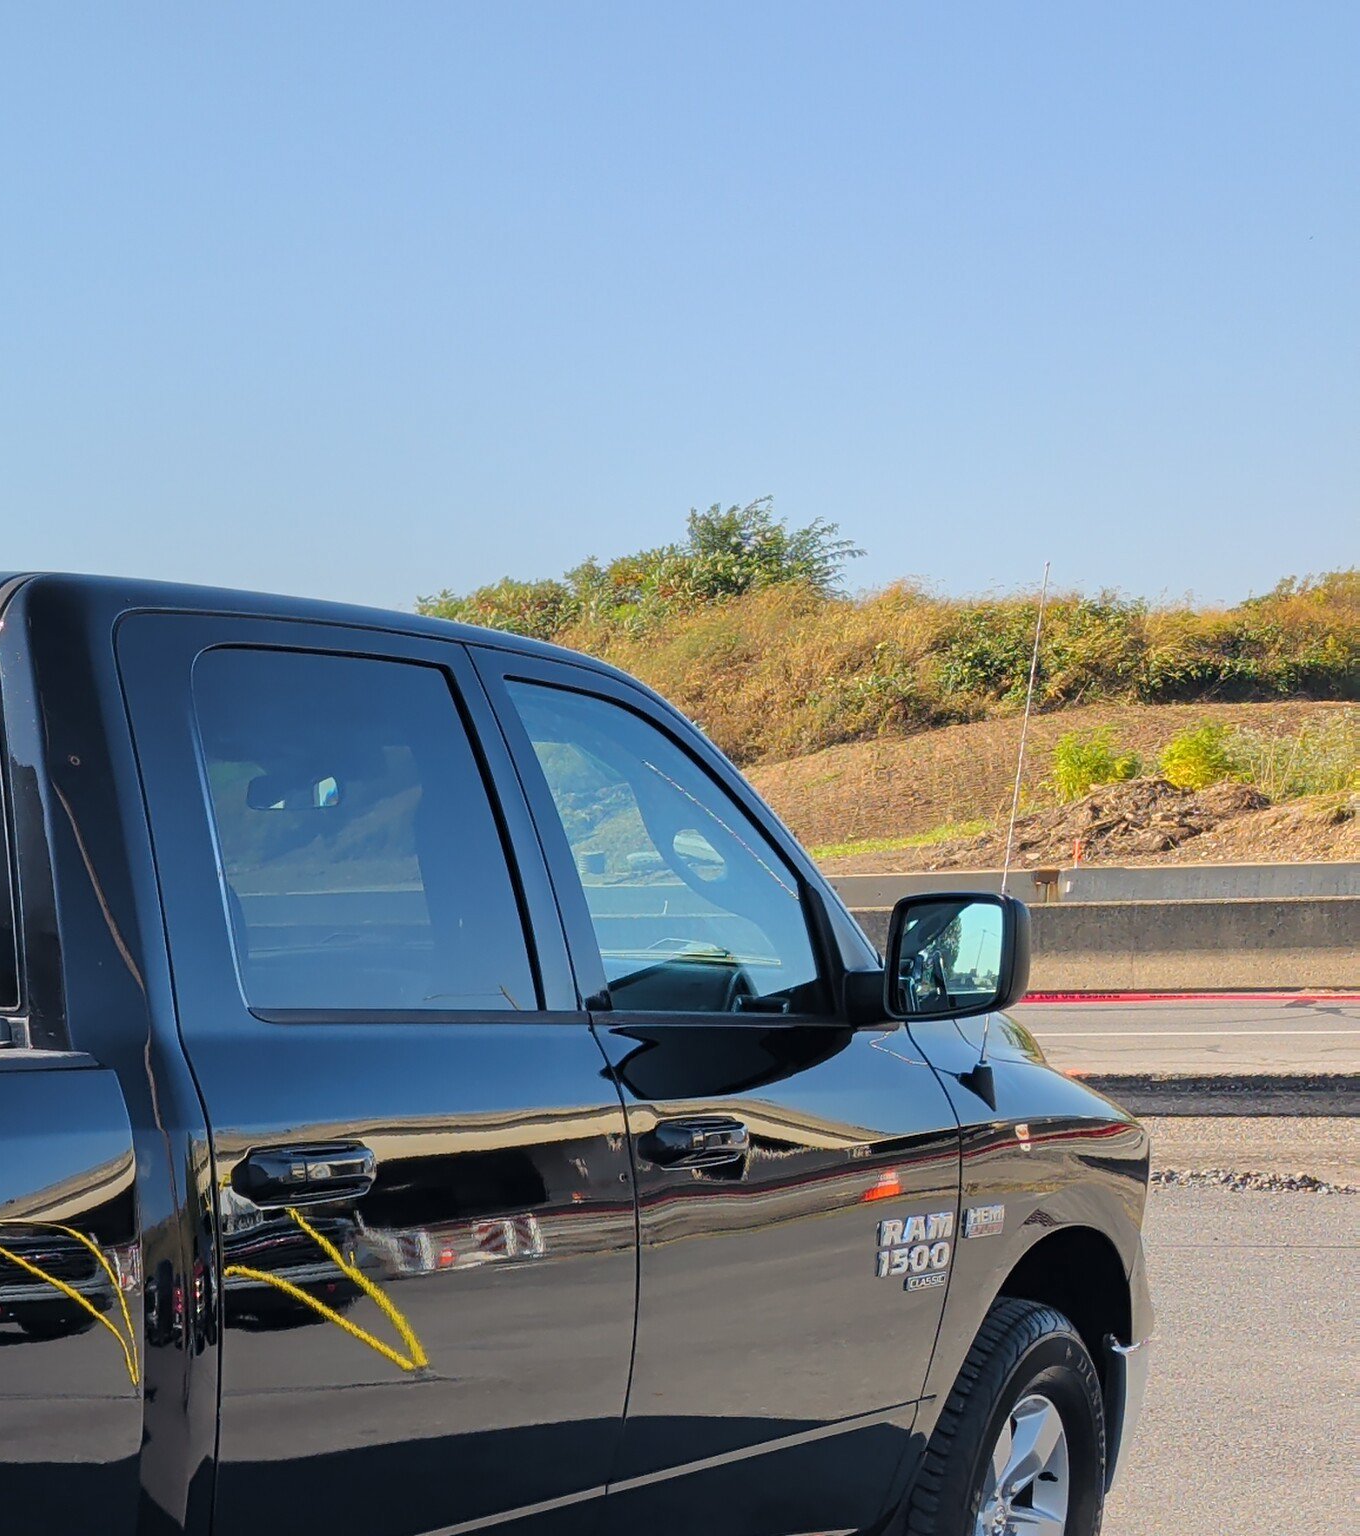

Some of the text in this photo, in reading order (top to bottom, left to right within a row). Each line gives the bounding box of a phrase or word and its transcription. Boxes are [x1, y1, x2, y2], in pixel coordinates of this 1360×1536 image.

[970, 1205, 1005, 1225] HEMI
[880, 1211, 954, 1247] RAM
[878, 1242, 951, 1277] 1500
[909, 1275, 946, 1289] CLASSIC
